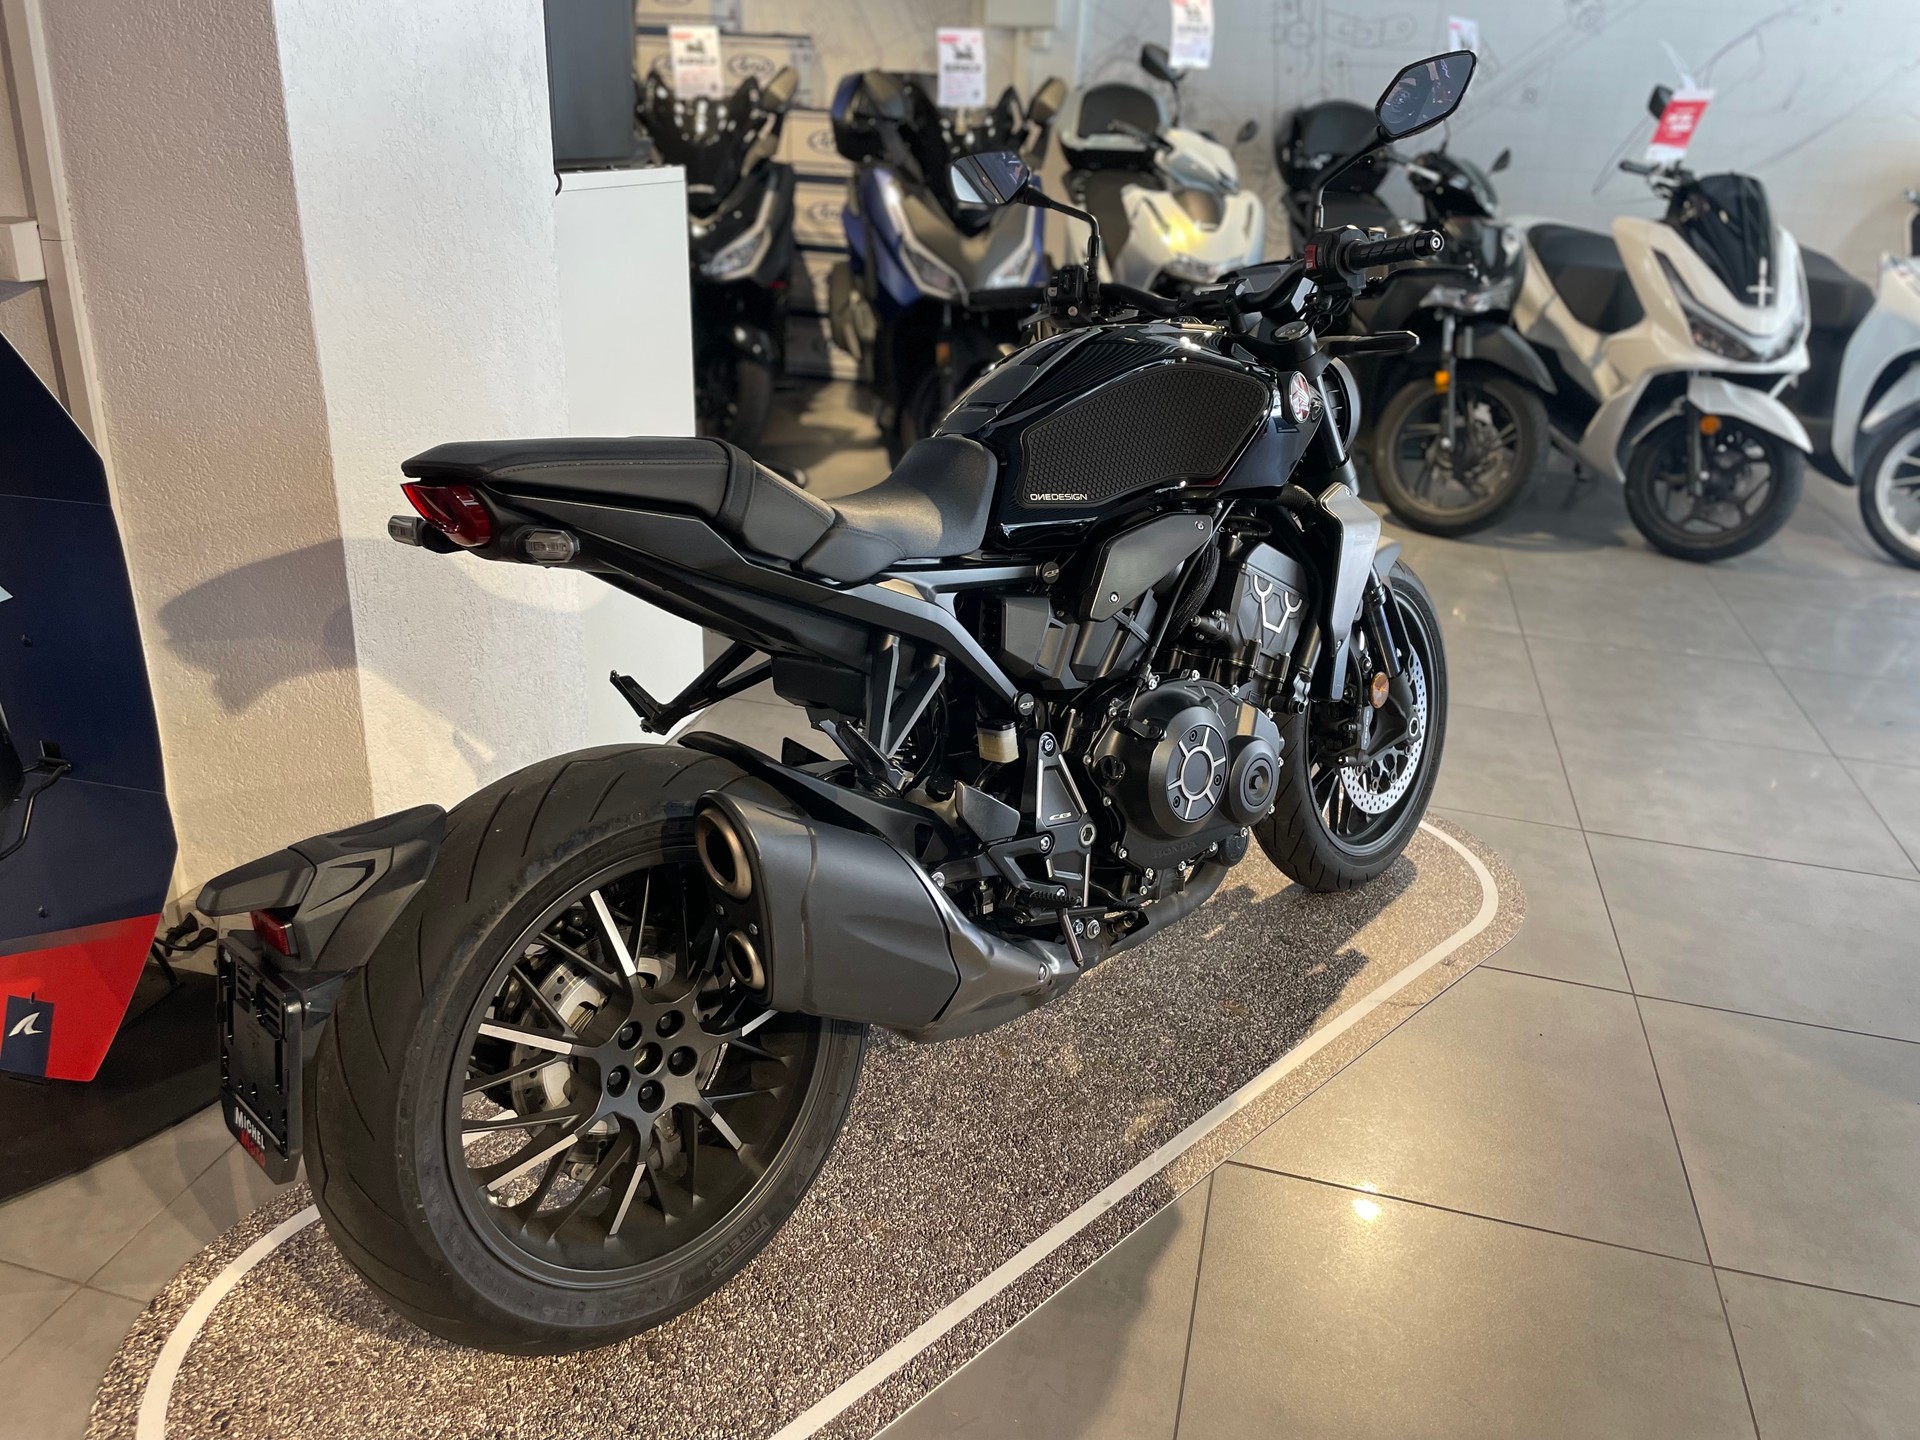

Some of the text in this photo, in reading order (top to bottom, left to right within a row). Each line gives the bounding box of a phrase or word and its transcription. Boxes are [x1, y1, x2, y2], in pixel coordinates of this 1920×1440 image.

[1030, 493, 1088, 501] ONEDESIGN
[234, 1106, 266, 1150] MICHEL
[706, 1213, 772, 1277] PIRELLI
